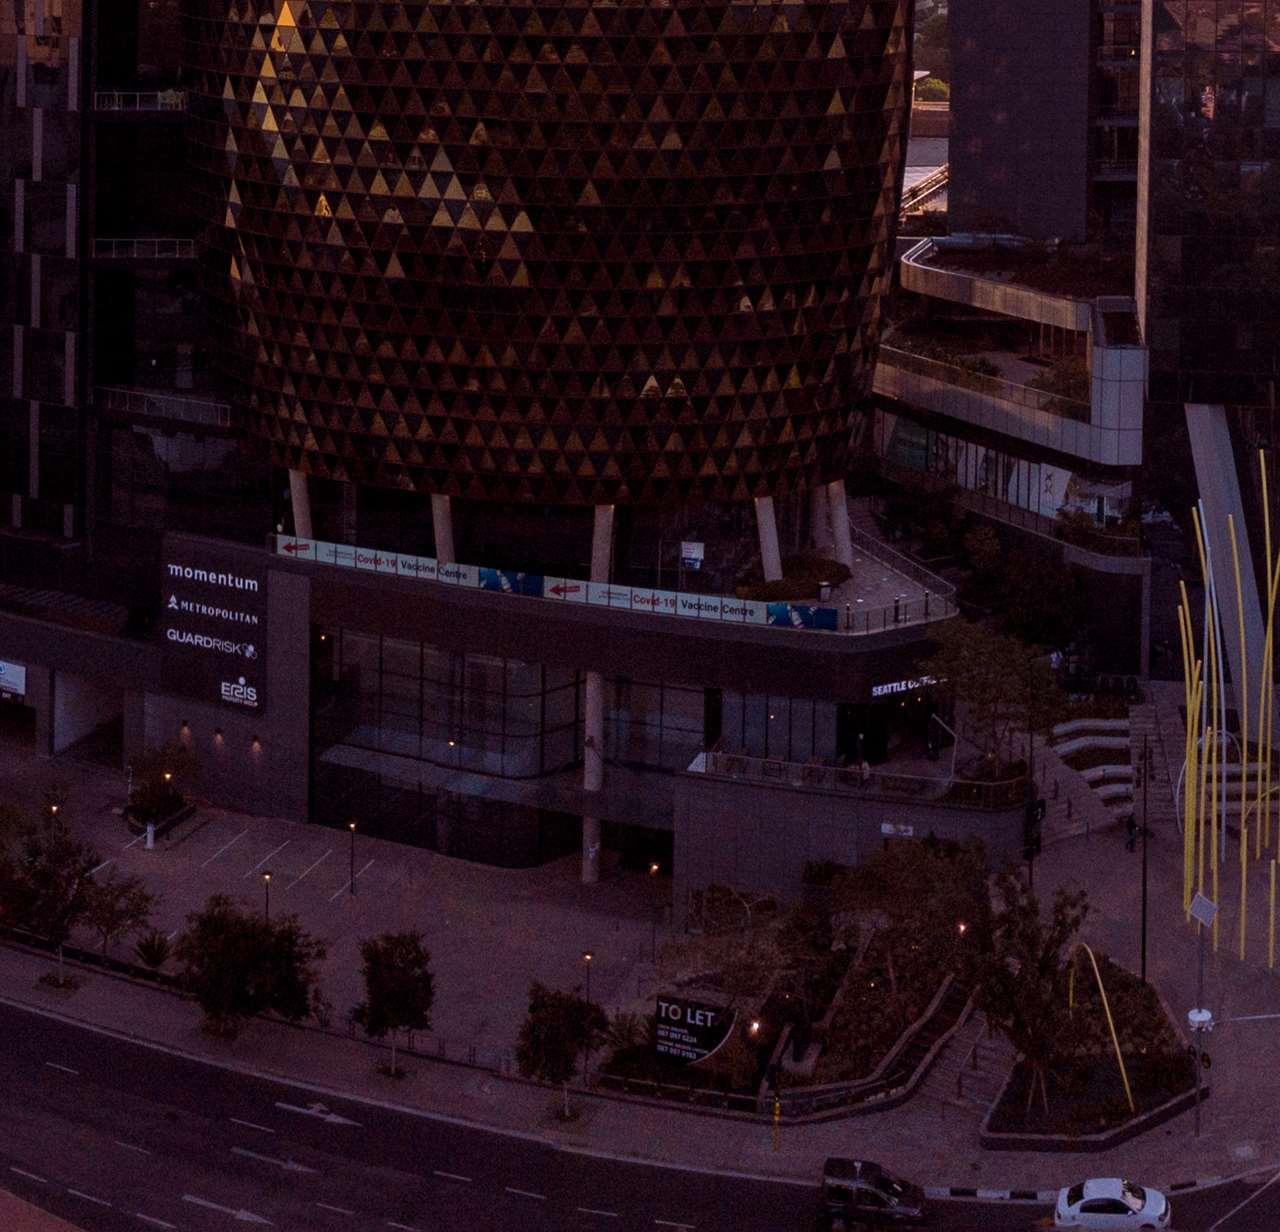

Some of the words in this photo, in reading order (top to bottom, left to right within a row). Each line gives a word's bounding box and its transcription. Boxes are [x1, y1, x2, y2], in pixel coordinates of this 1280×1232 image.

[168, 564, 258, 592] momentum
[358, 555, 396, 567] Covid-19
[401, 561, 435, 574] Vaccine
[438, 565, 467, 580] Centre
[181, 600, 258, 624] METROPOLITAN
[633, 595, 675, 609] Covid-19
[681, 600, 719, 614] Vaccine
[722, 604, 754, 617] Centre
[167, 629, 242, 655] GUARDRISK
[221, 679, 258, 700] ERIS
[872, 680, 907, 696] SEATTLE
[659, 1000, 681, 1020] TO
[687, 1008, 715, 1027] LET
